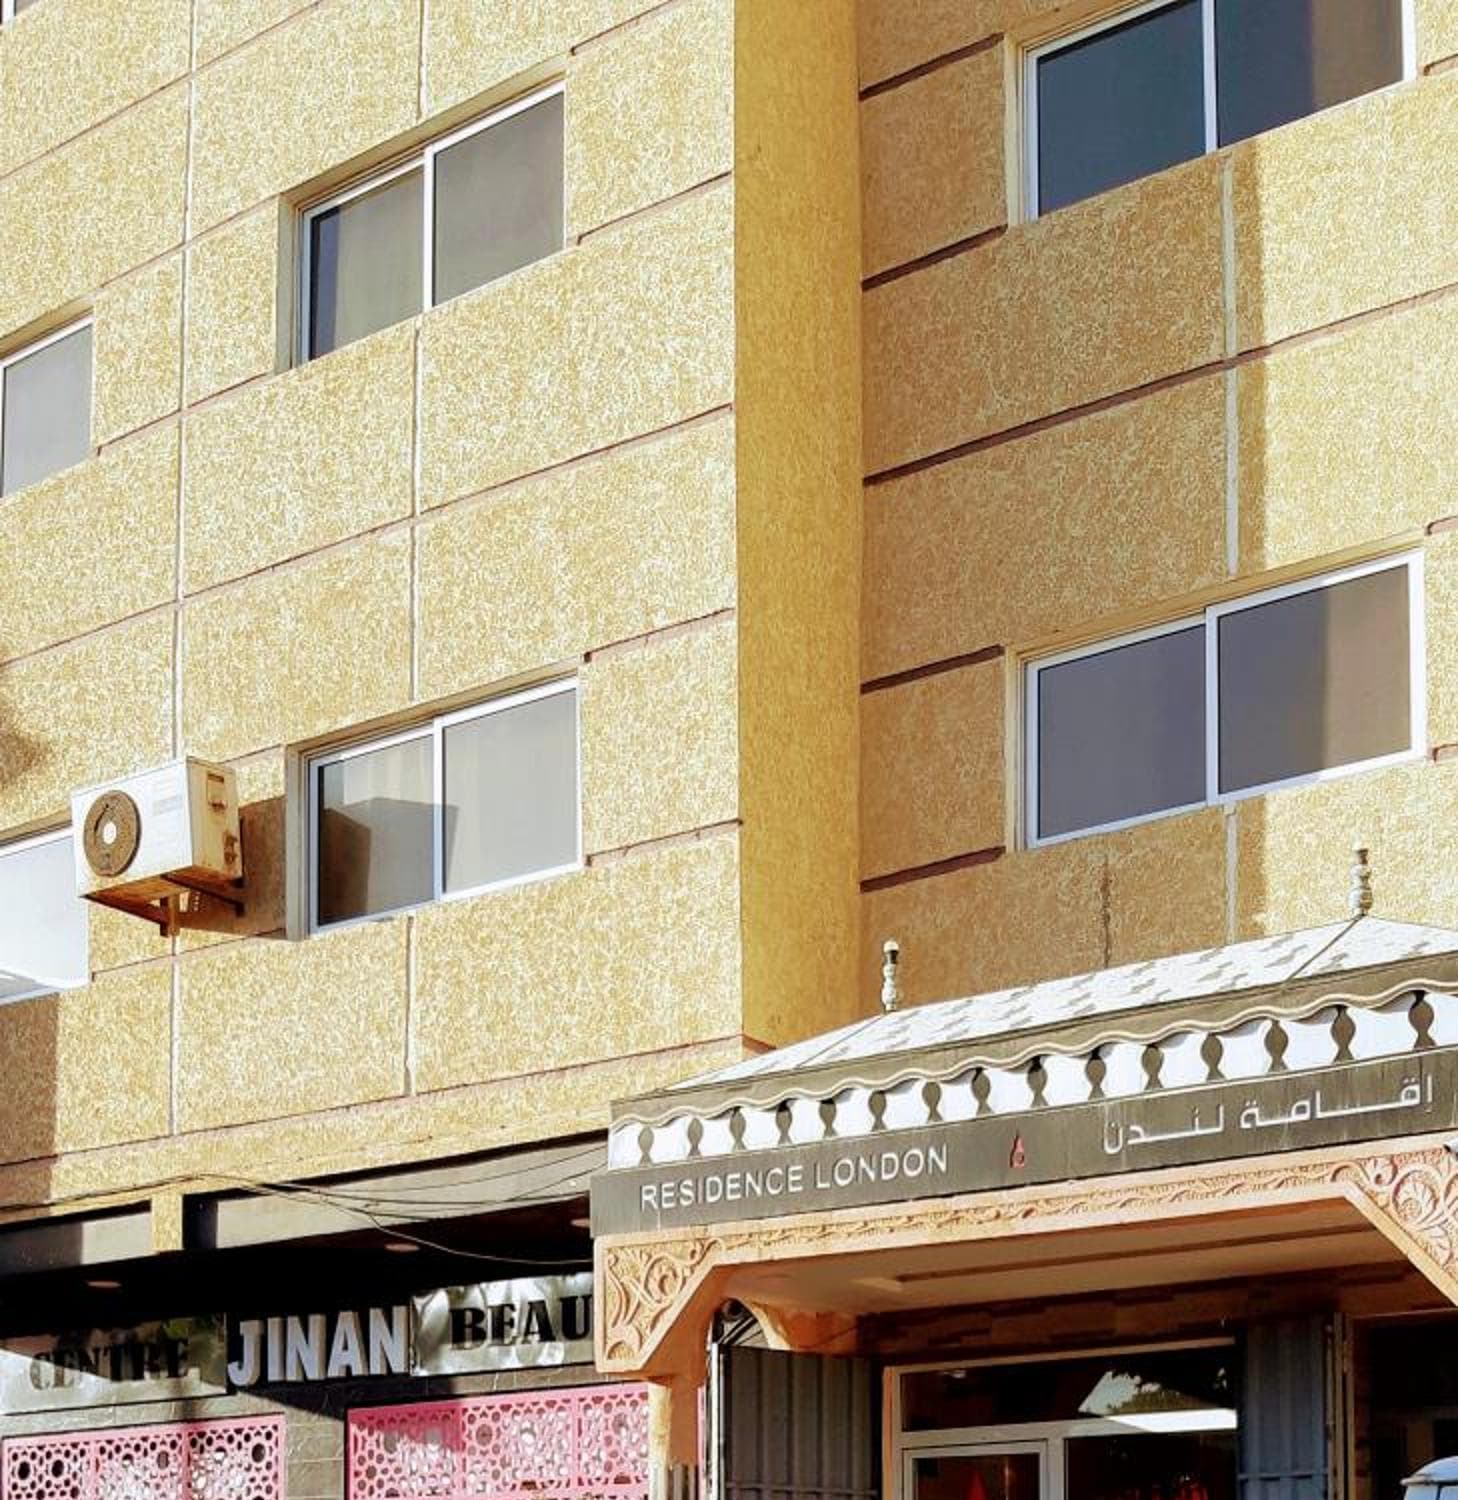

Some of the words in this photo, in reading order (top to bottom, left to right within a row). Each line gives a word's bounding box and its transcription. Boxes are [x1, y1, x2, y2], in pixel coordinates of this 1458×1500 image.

[1103, 1104, 1225, 1155] لندن
[640, 1163, 803, 1212] RESIDENCE
[815, 1143, 948, 1190] LONDON
[28, 1337, 190, 1391] CENTRE
[228, 1306, 410, 1386] JINAN
